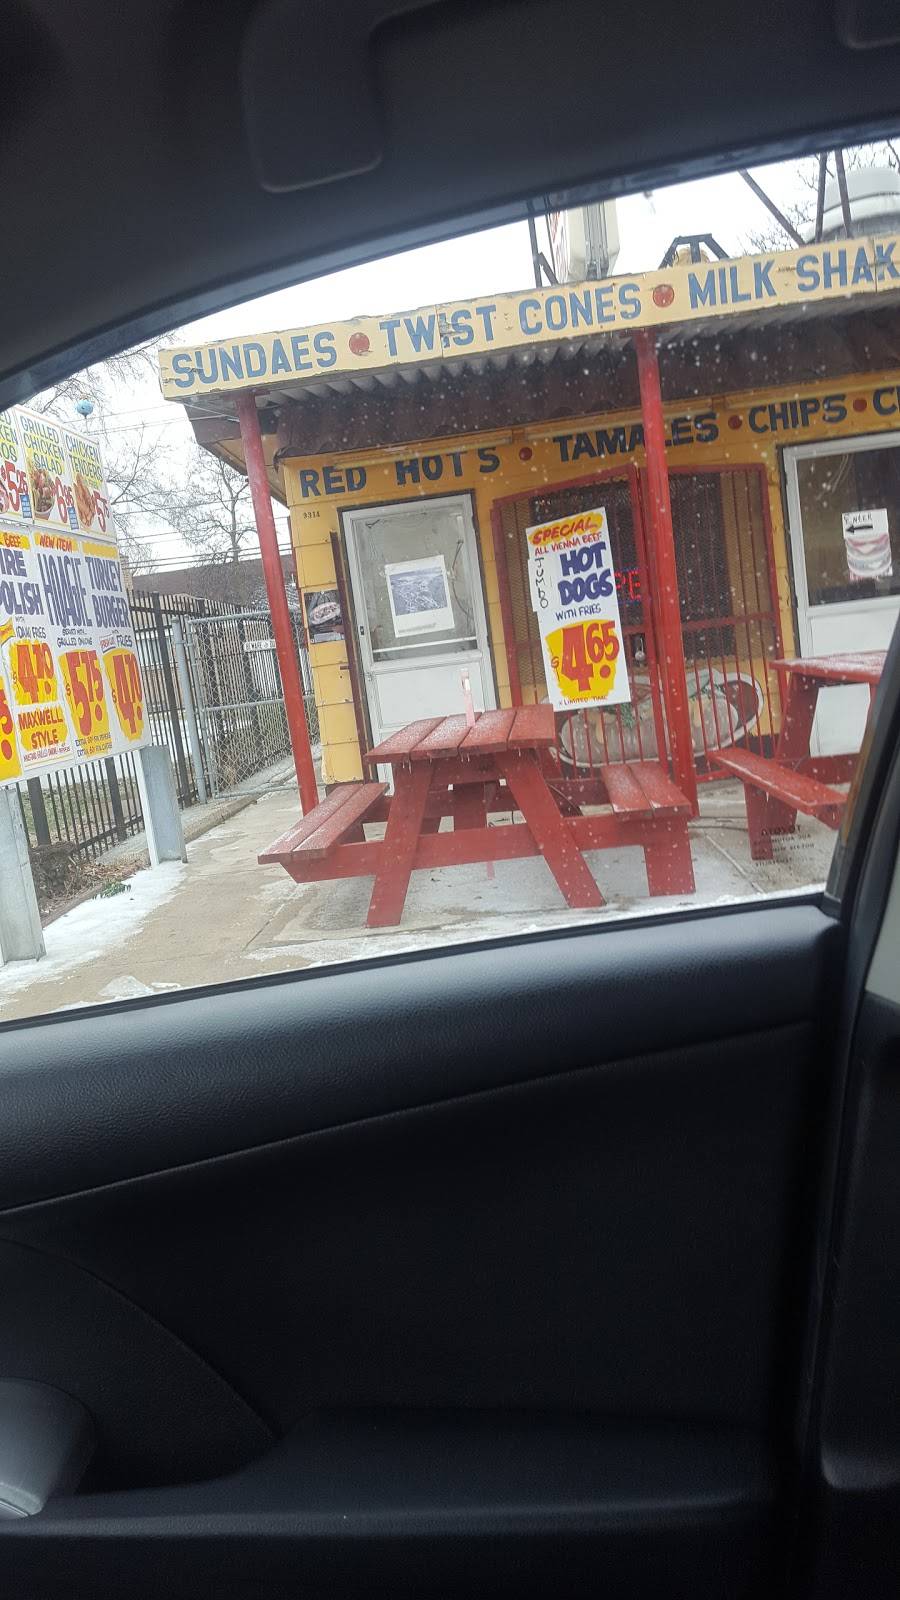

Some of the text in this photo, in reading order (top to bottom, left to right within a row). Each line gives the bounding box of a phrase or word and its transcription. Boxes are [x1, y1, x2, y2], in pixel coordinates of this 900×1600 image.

[171, 331, 337, 388] SUNDAES
[519, 283, 642, 335] CONES
[688, 259, 778, 309] MILK
[795, 241, 900, 292] SHAK
[20, 415, 60, 444] GRILLED
[300, 465, 367, 498] RED
[748, 393, 847, 434] CHIPS
[872, 385, 900, 416] C
[23, 432, 65, 461] CHICKEN
[65, 434, 99, 464] CHICKEN
[33, 452, 64, 476] SALAD
[40, 535, 73, 553] NEW ITEM
[532, 517, 599, 545] SPECIAL
[534, 531, 603, 556] ALL VIENNA BEEF
[0, 548, 27, 577] IRE
[560, 541, 606, 577] HOT
[84, 556, 123, 592] TURKEY
[557, 569, 615, 606] DOGS
[0, 580, 44, 616] OLISH
[91, 594, 131, 628] BURGER
[555, 603, 602, 622] WITH FRIES
[18, 707, 63, 731] MAXWELL
[31, 728, 60, 750] STYLE
